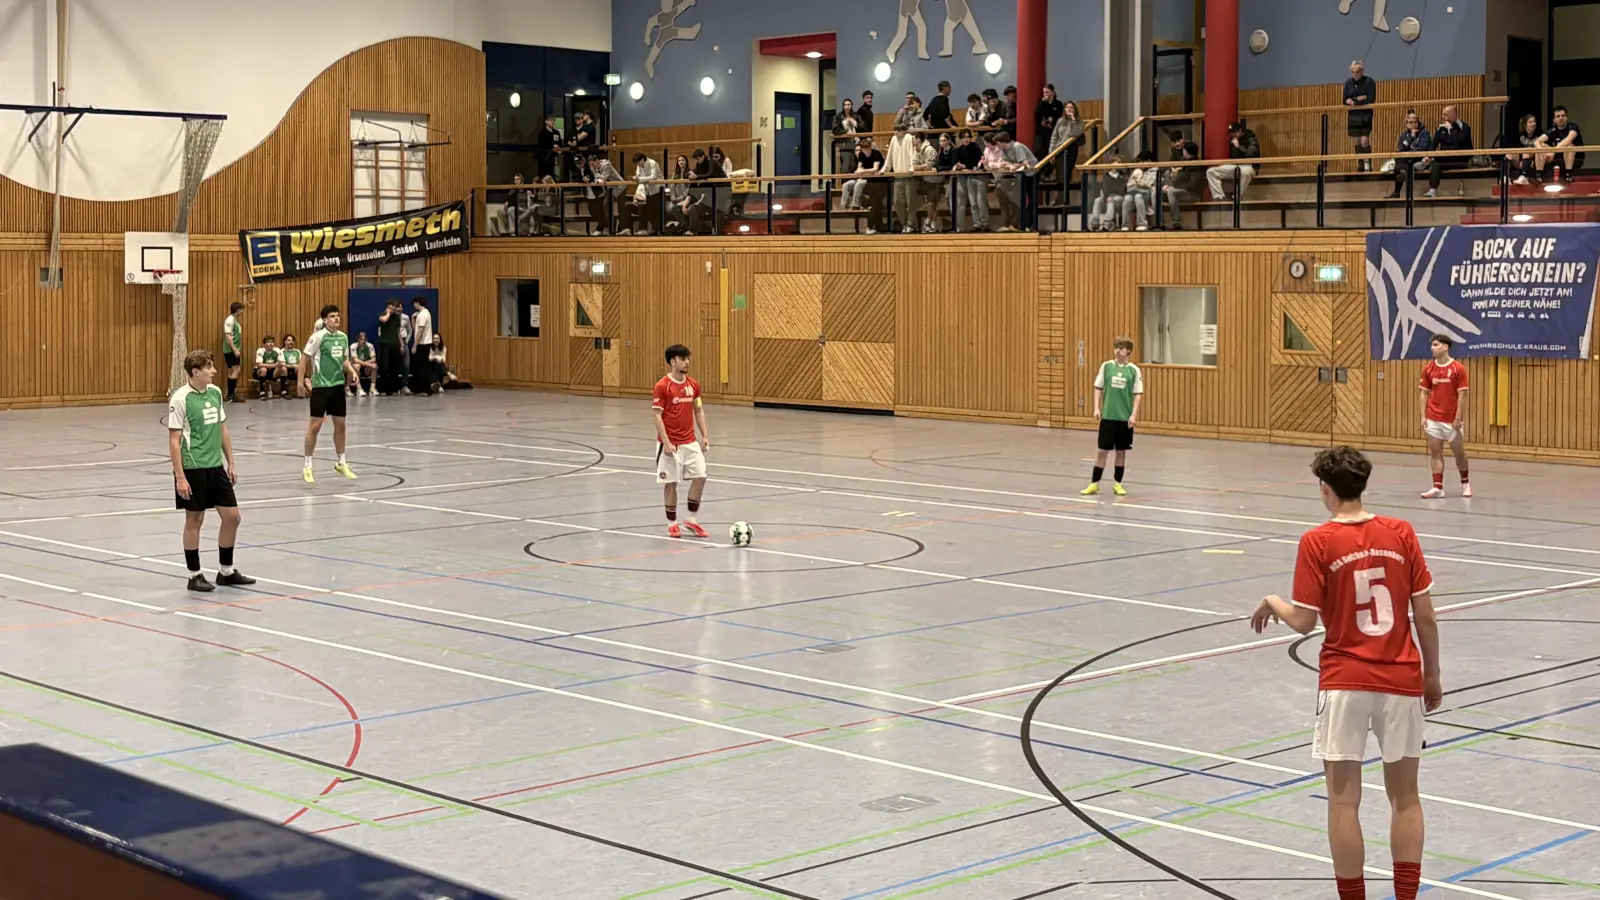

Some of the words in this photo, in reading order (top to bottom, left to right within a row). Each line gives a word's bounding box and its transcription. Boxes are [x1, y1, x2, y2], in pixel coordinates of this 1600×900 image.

[295, 260, 300, 270] 2
[306, 258, 313, 268] in
[314, 256, 340, 267] Amberg
[347, 249, 385, 262] Ursensollen
[392, 242, 418, 256] Ensdorf
[425, 236, 461, 250] Lauterhofen
[1472, 238, 1517, 260] BOCK
[1520, 238, 1556, 258] AUF
[253, 265, 281, 274] EDEKA
[1450, 260, 1586, 286] FÜHRERSCHEIN?
[1461, 288, 1484, 298] DANN
[1508, 288, 1526, 296] DICH
[1529, 288, 1555, 297] JETZT
[1556, 288, 1572, 297] AN!
[1489, 300, 1498, 308] IN
[1501, 300, 1532, 309] DEINER
[1533, 298, 1560, 309] NÄHE!
[1353, 566, 1394, 636] 5
